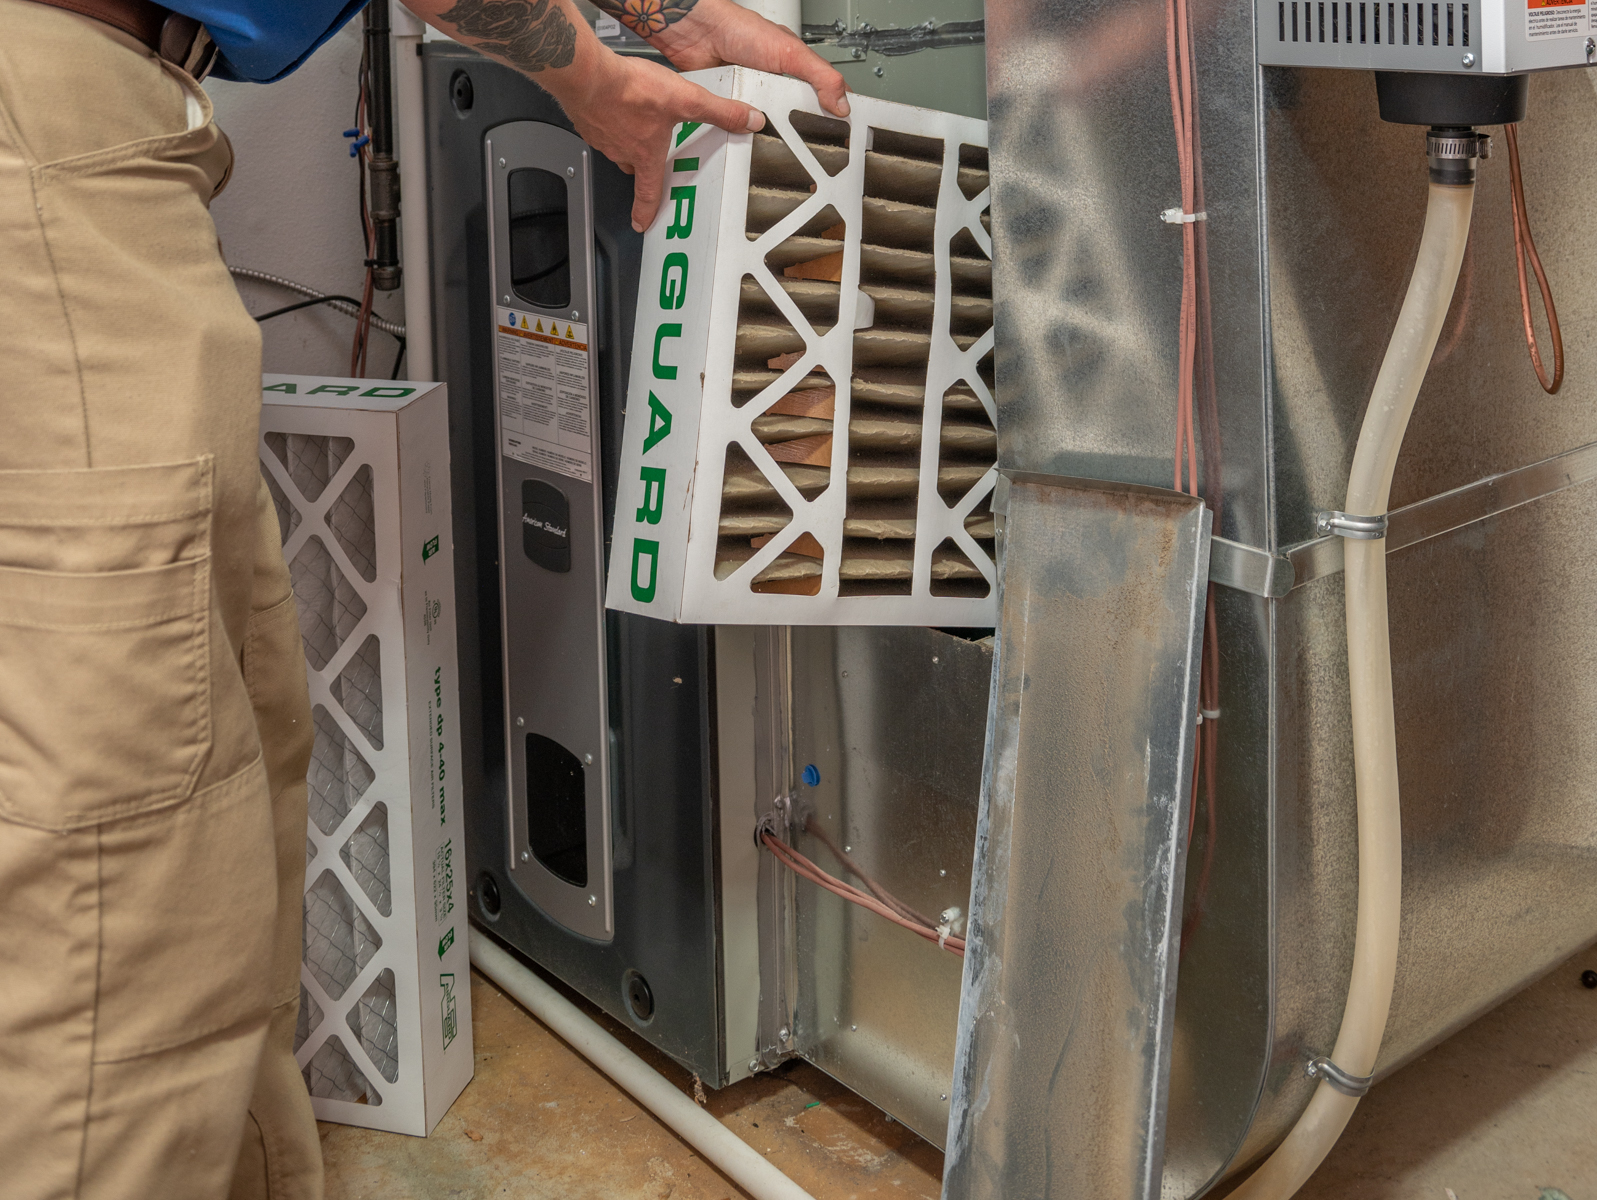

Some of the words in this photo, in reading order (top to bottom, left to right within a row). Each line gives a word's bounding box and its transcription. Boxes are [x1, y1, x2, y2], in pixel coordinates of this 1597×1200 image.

[522, 513, 543, 528] American
[543, 521, 568, 538] Standard
[434, 667, 443, 708] type
[435, 714, 444, 737] dp
[439, 786, 447, 827] max
[444, 838, 454, 913] 16x25x4
